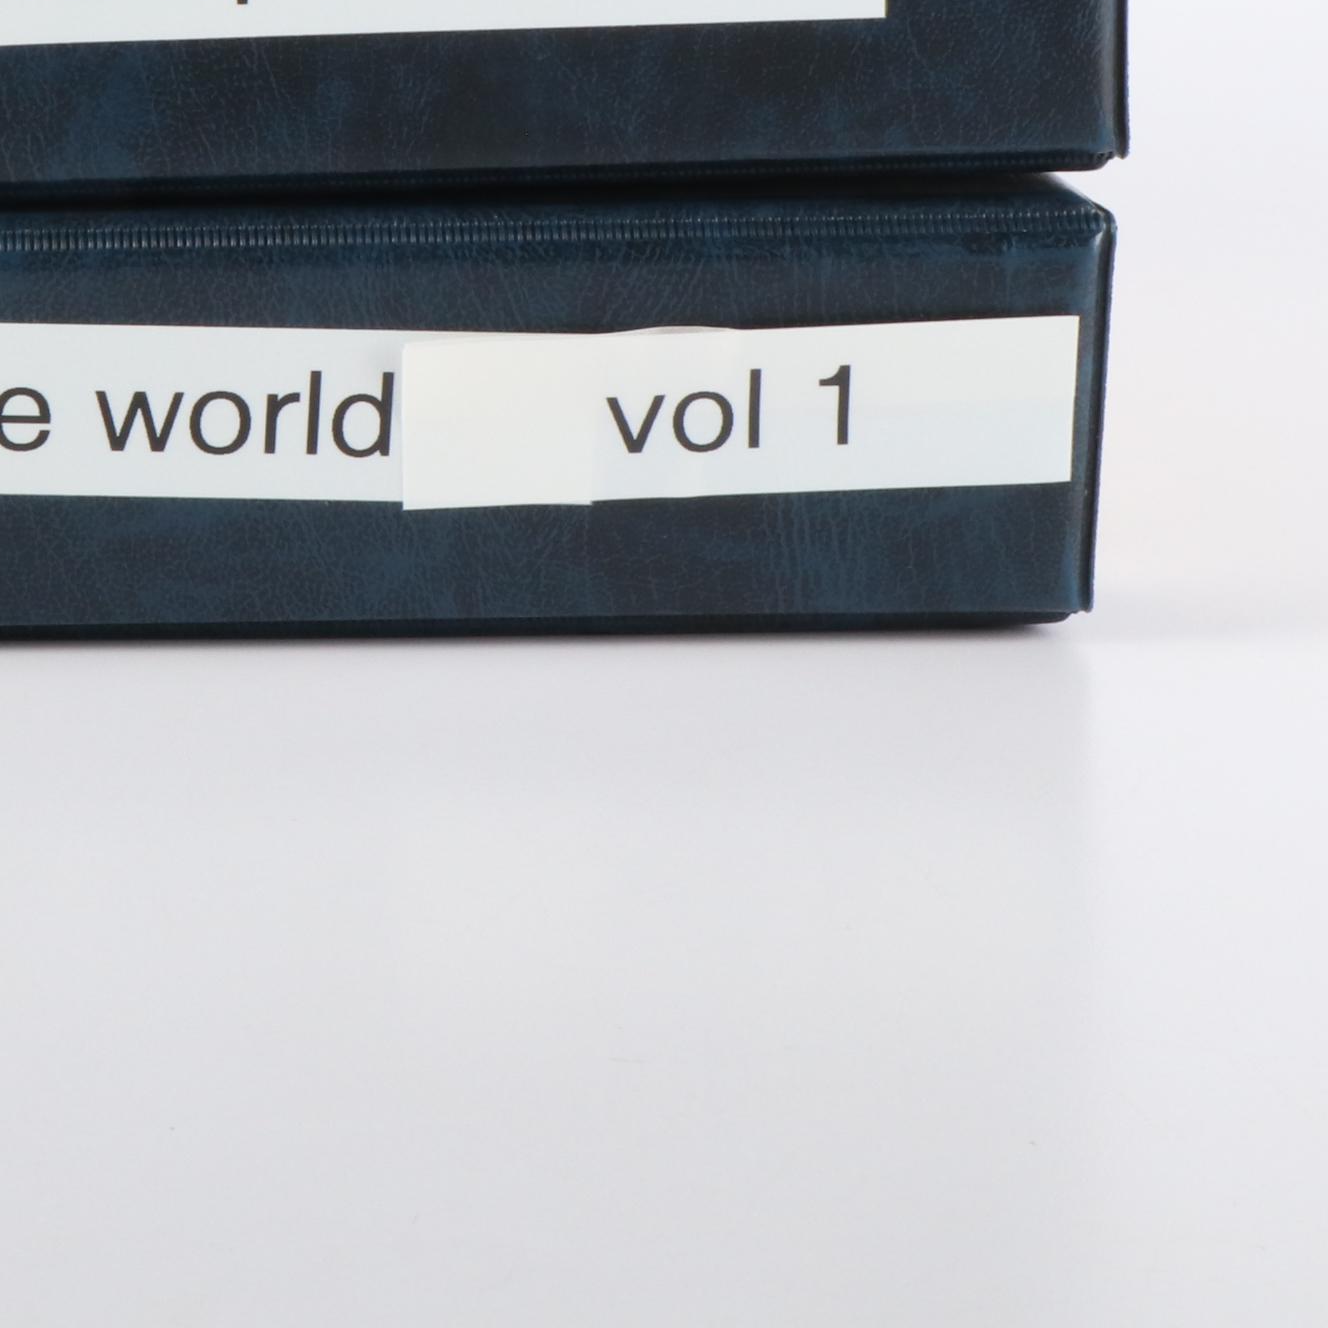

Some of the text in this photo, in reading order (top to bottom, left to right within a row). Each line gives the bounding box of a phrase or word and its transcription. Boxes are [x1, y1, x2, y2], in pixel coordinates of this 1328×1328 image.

[96, 371, 394, 457] world
[607, 369, 761, 453] vol
[820, 365, 850, 444] 1
